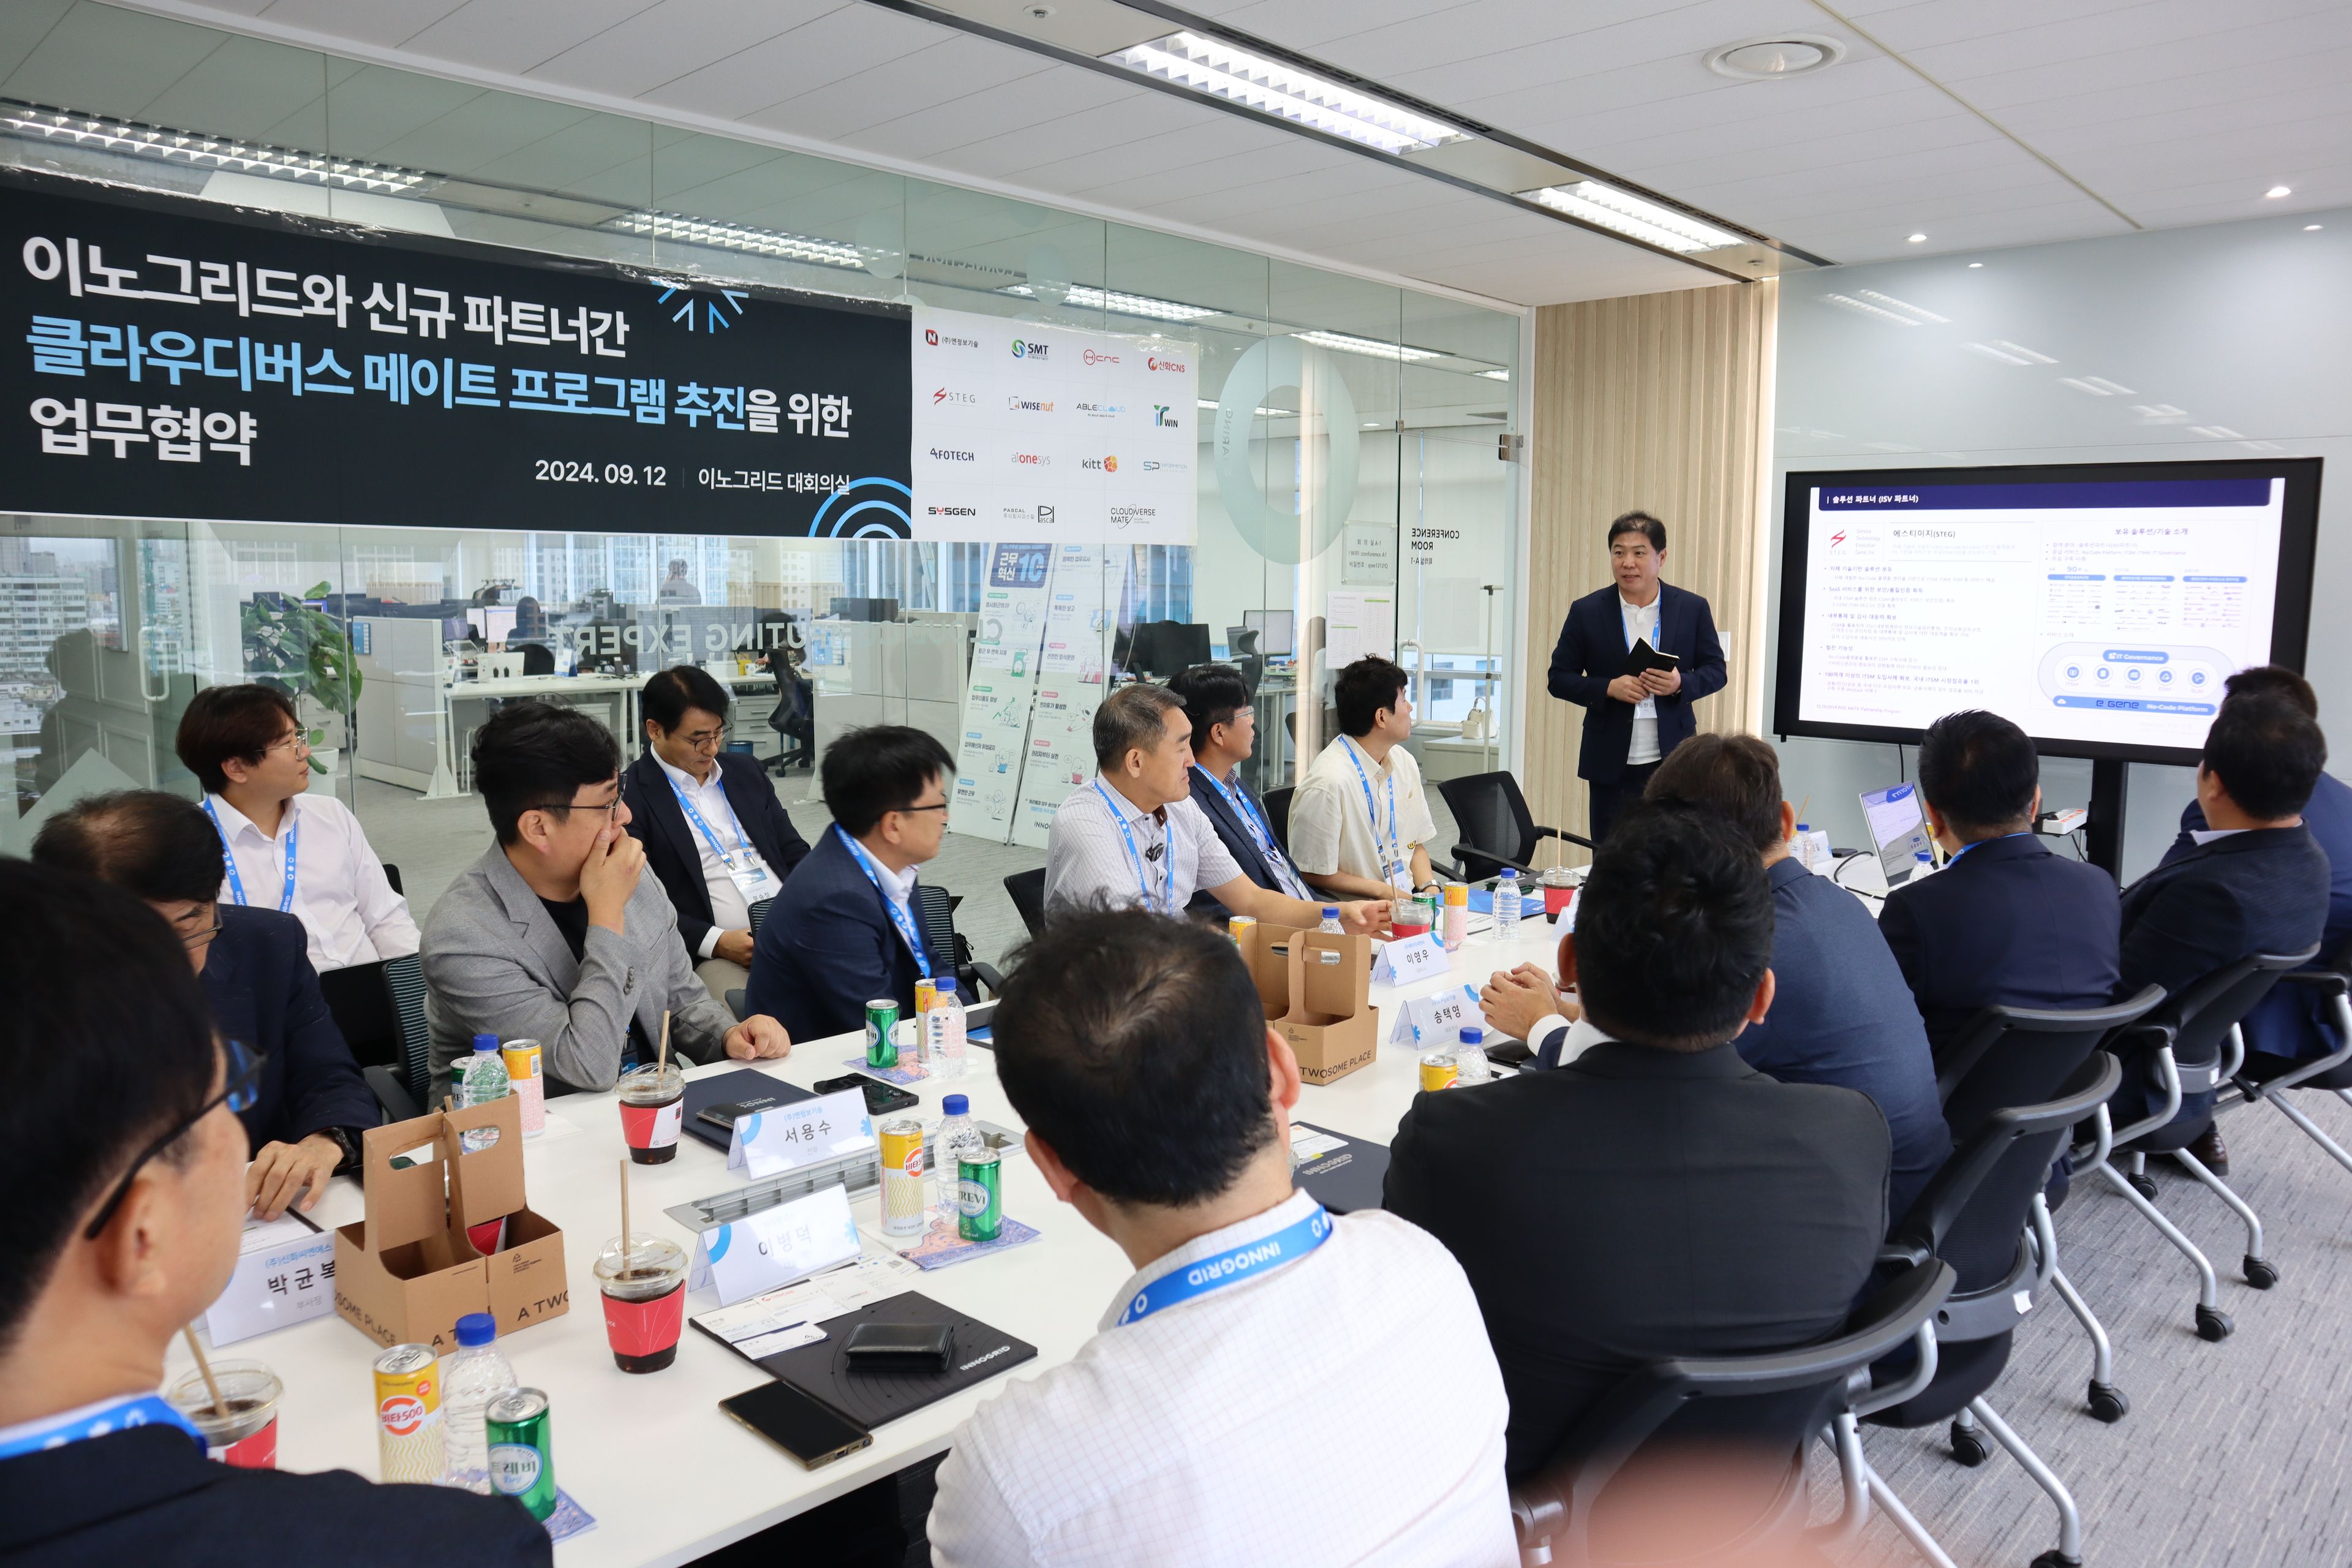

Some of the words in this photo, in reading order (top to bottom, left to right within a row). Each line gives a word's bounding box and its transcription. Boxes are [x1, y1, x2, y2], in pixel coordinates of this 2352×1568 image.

[22, 236, 353, 328] 이노그리드와
[362, 282, 456, 339] 신규
[463, 295, 630, 358] 파트너간
[942, 337, 978, 348] (주)엔정보기술
[1028, 343, 1049, 355] SMT
[1159, 361, 1185, 372] 신화CNS
[26, 315, 355, 396] 클라우디버스
[364, 353, 500, 409] 메이트
[509, 368, 665, 425] 프로그램
[674, 382, 780, 434] 추진을
[788, 391, 852, 438] 위한
[949, 392, 975, 403] STEG
[1021, 401, 1054, 412] WISEnut
[30, 398, 257, 466] 업무협약
[1011, 452, 1050, 467] aionesys
[1082, 458, 1101, 469] kitt
[1144, 461, 1159, 471] SP
[535, 459, 600, 483] 2024.
[604, 463, 638, 485] 09.
[643, 466, 666, 486] 12
[698, 467, 783, 491] 이노그리드
[788, 472, 850, 496] 대회의실
[1000, 552, 1019, 566] 근무
[997, 568, 1015, 581] 혁신
[1133, 853, 1143, 884] INNOGRID
[1434, 1005, 1461, 1024] 송택영
[1300, 1061, 1348, 1078] TWOSOME
[1350, 1050, 1371, 1067] PLACE
[785, 1106, 823, 1122] (주)엔정보기술
[785, 1120, 832, 1144] 서용수
[1302, 1153, 1352, 1175] INNOGRID
[265, 1244, 333, 1268] (주)신화씨엔에스
[1188, 1240, 1281, 1286] INNOGRID
[517, 1308, 530, 1321] A
[365, 1314, 396, 1345] PLACE
[432, 1334, 444, 1347] A
[959, 1346, 1011, 1371] INNOGRID
[381, 1406, 423, 1423] 비타500
